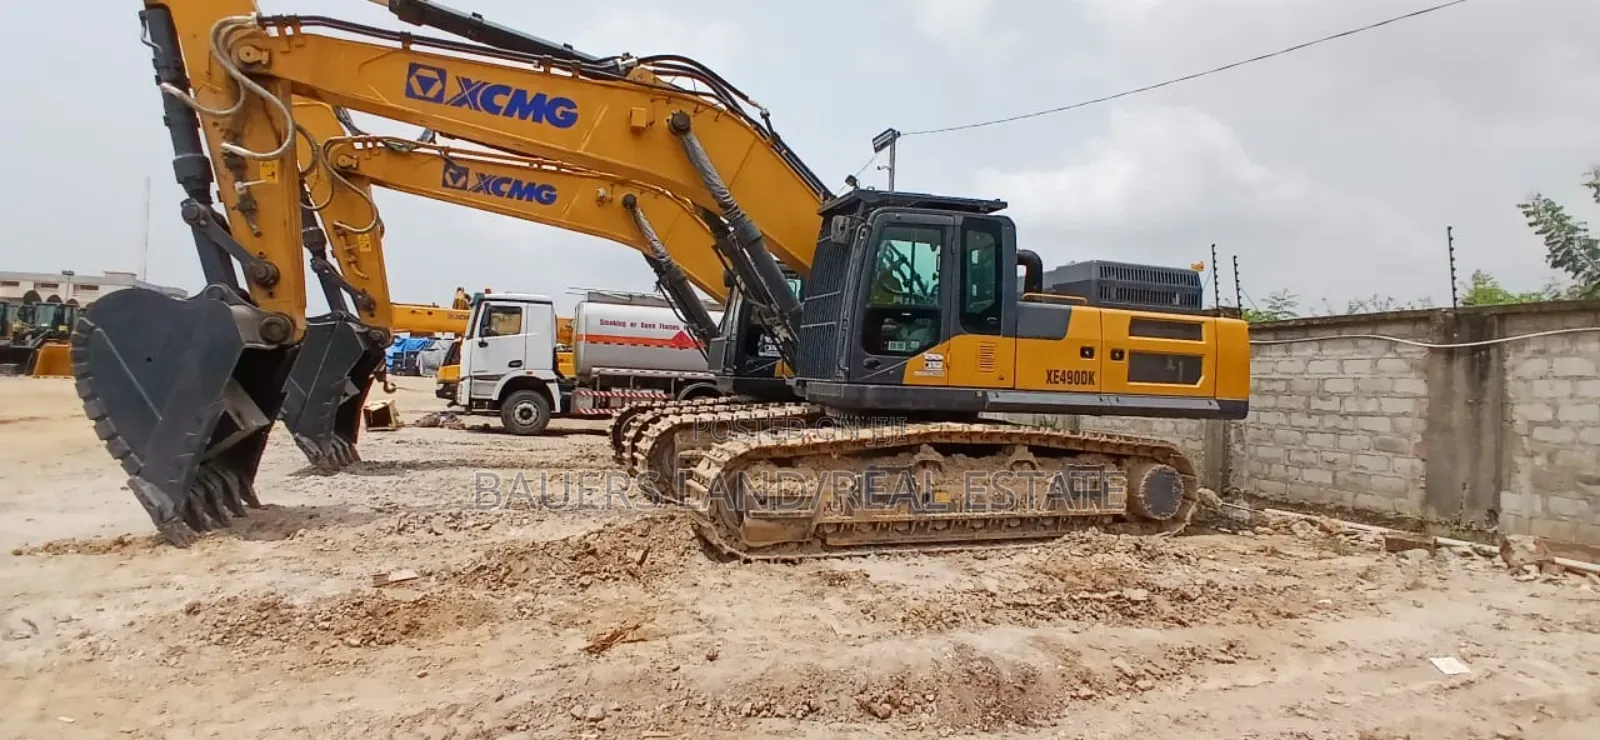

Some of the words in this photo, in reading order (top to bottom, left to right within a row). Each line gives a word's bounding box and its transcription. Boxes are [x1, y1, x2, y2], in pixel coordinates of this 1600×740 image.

[445, 75, 579, 129] XCMG
[468, 171, 558, 206] XCMG
[600, 319, 626, 327] Smoking
